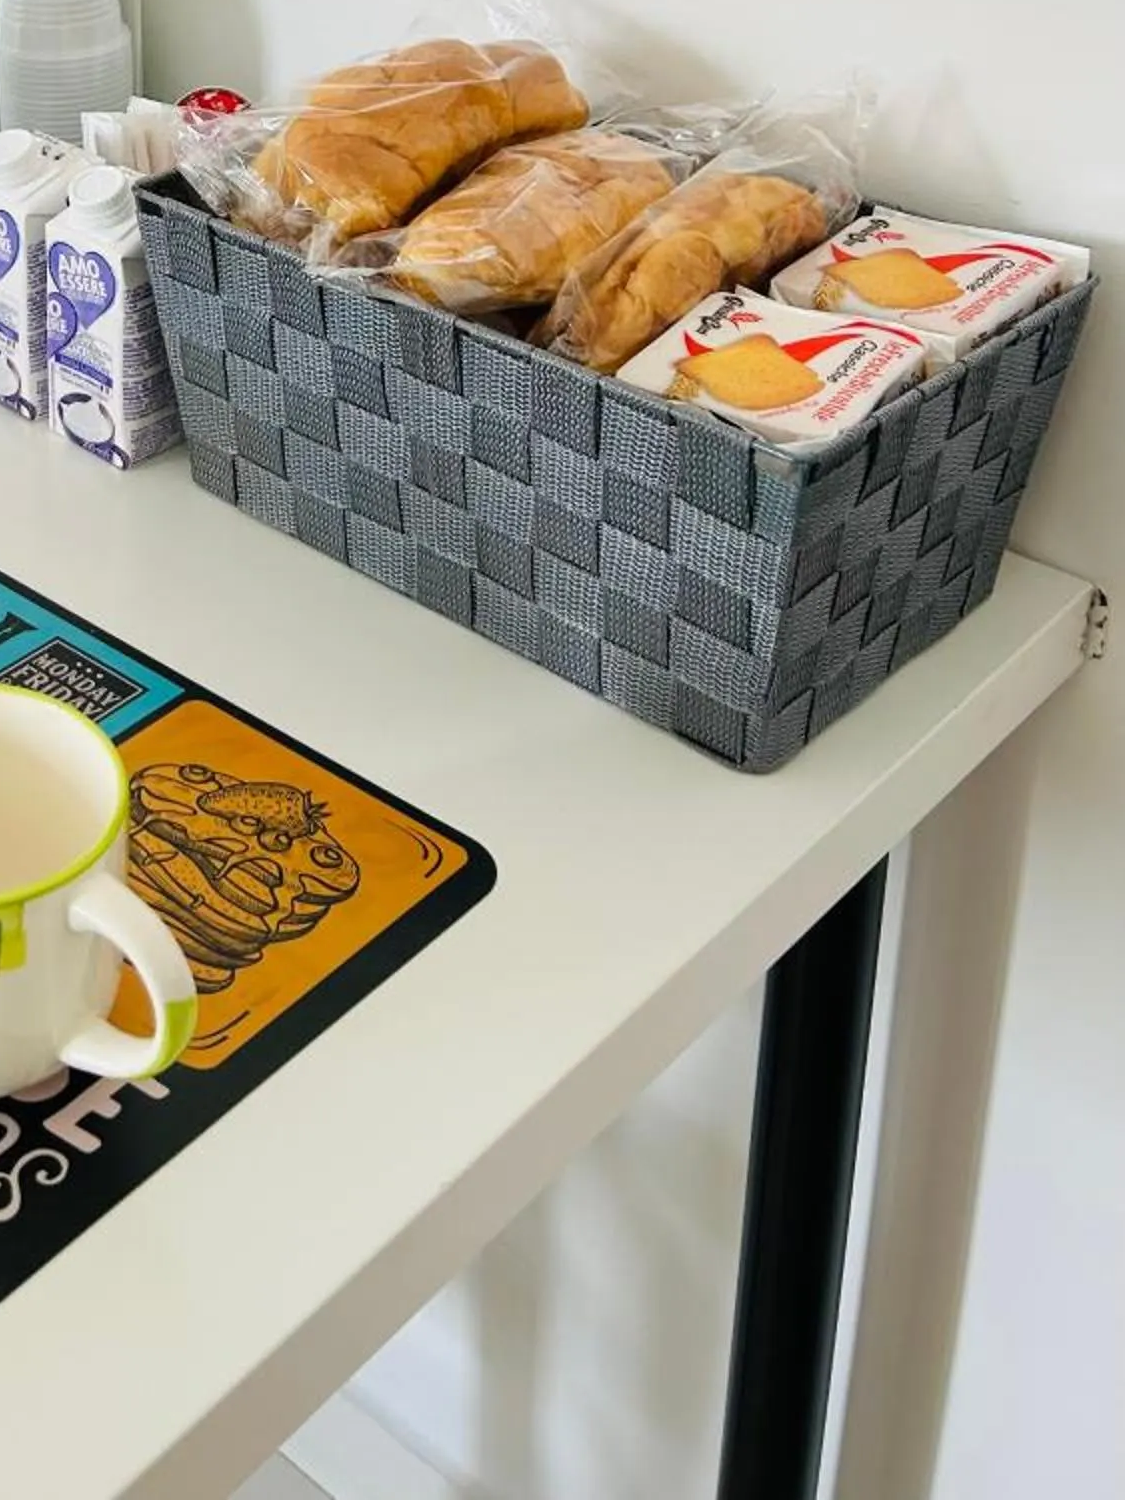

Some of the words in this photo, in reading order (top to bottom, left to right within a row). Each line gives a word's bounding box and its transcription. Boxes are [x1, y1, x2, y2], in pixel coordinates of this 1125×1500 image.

[58, 253, 100, 278] AMO
[58, 272, 108, 298] ESSERE
[33, 652, 122, 707] MONDAY
